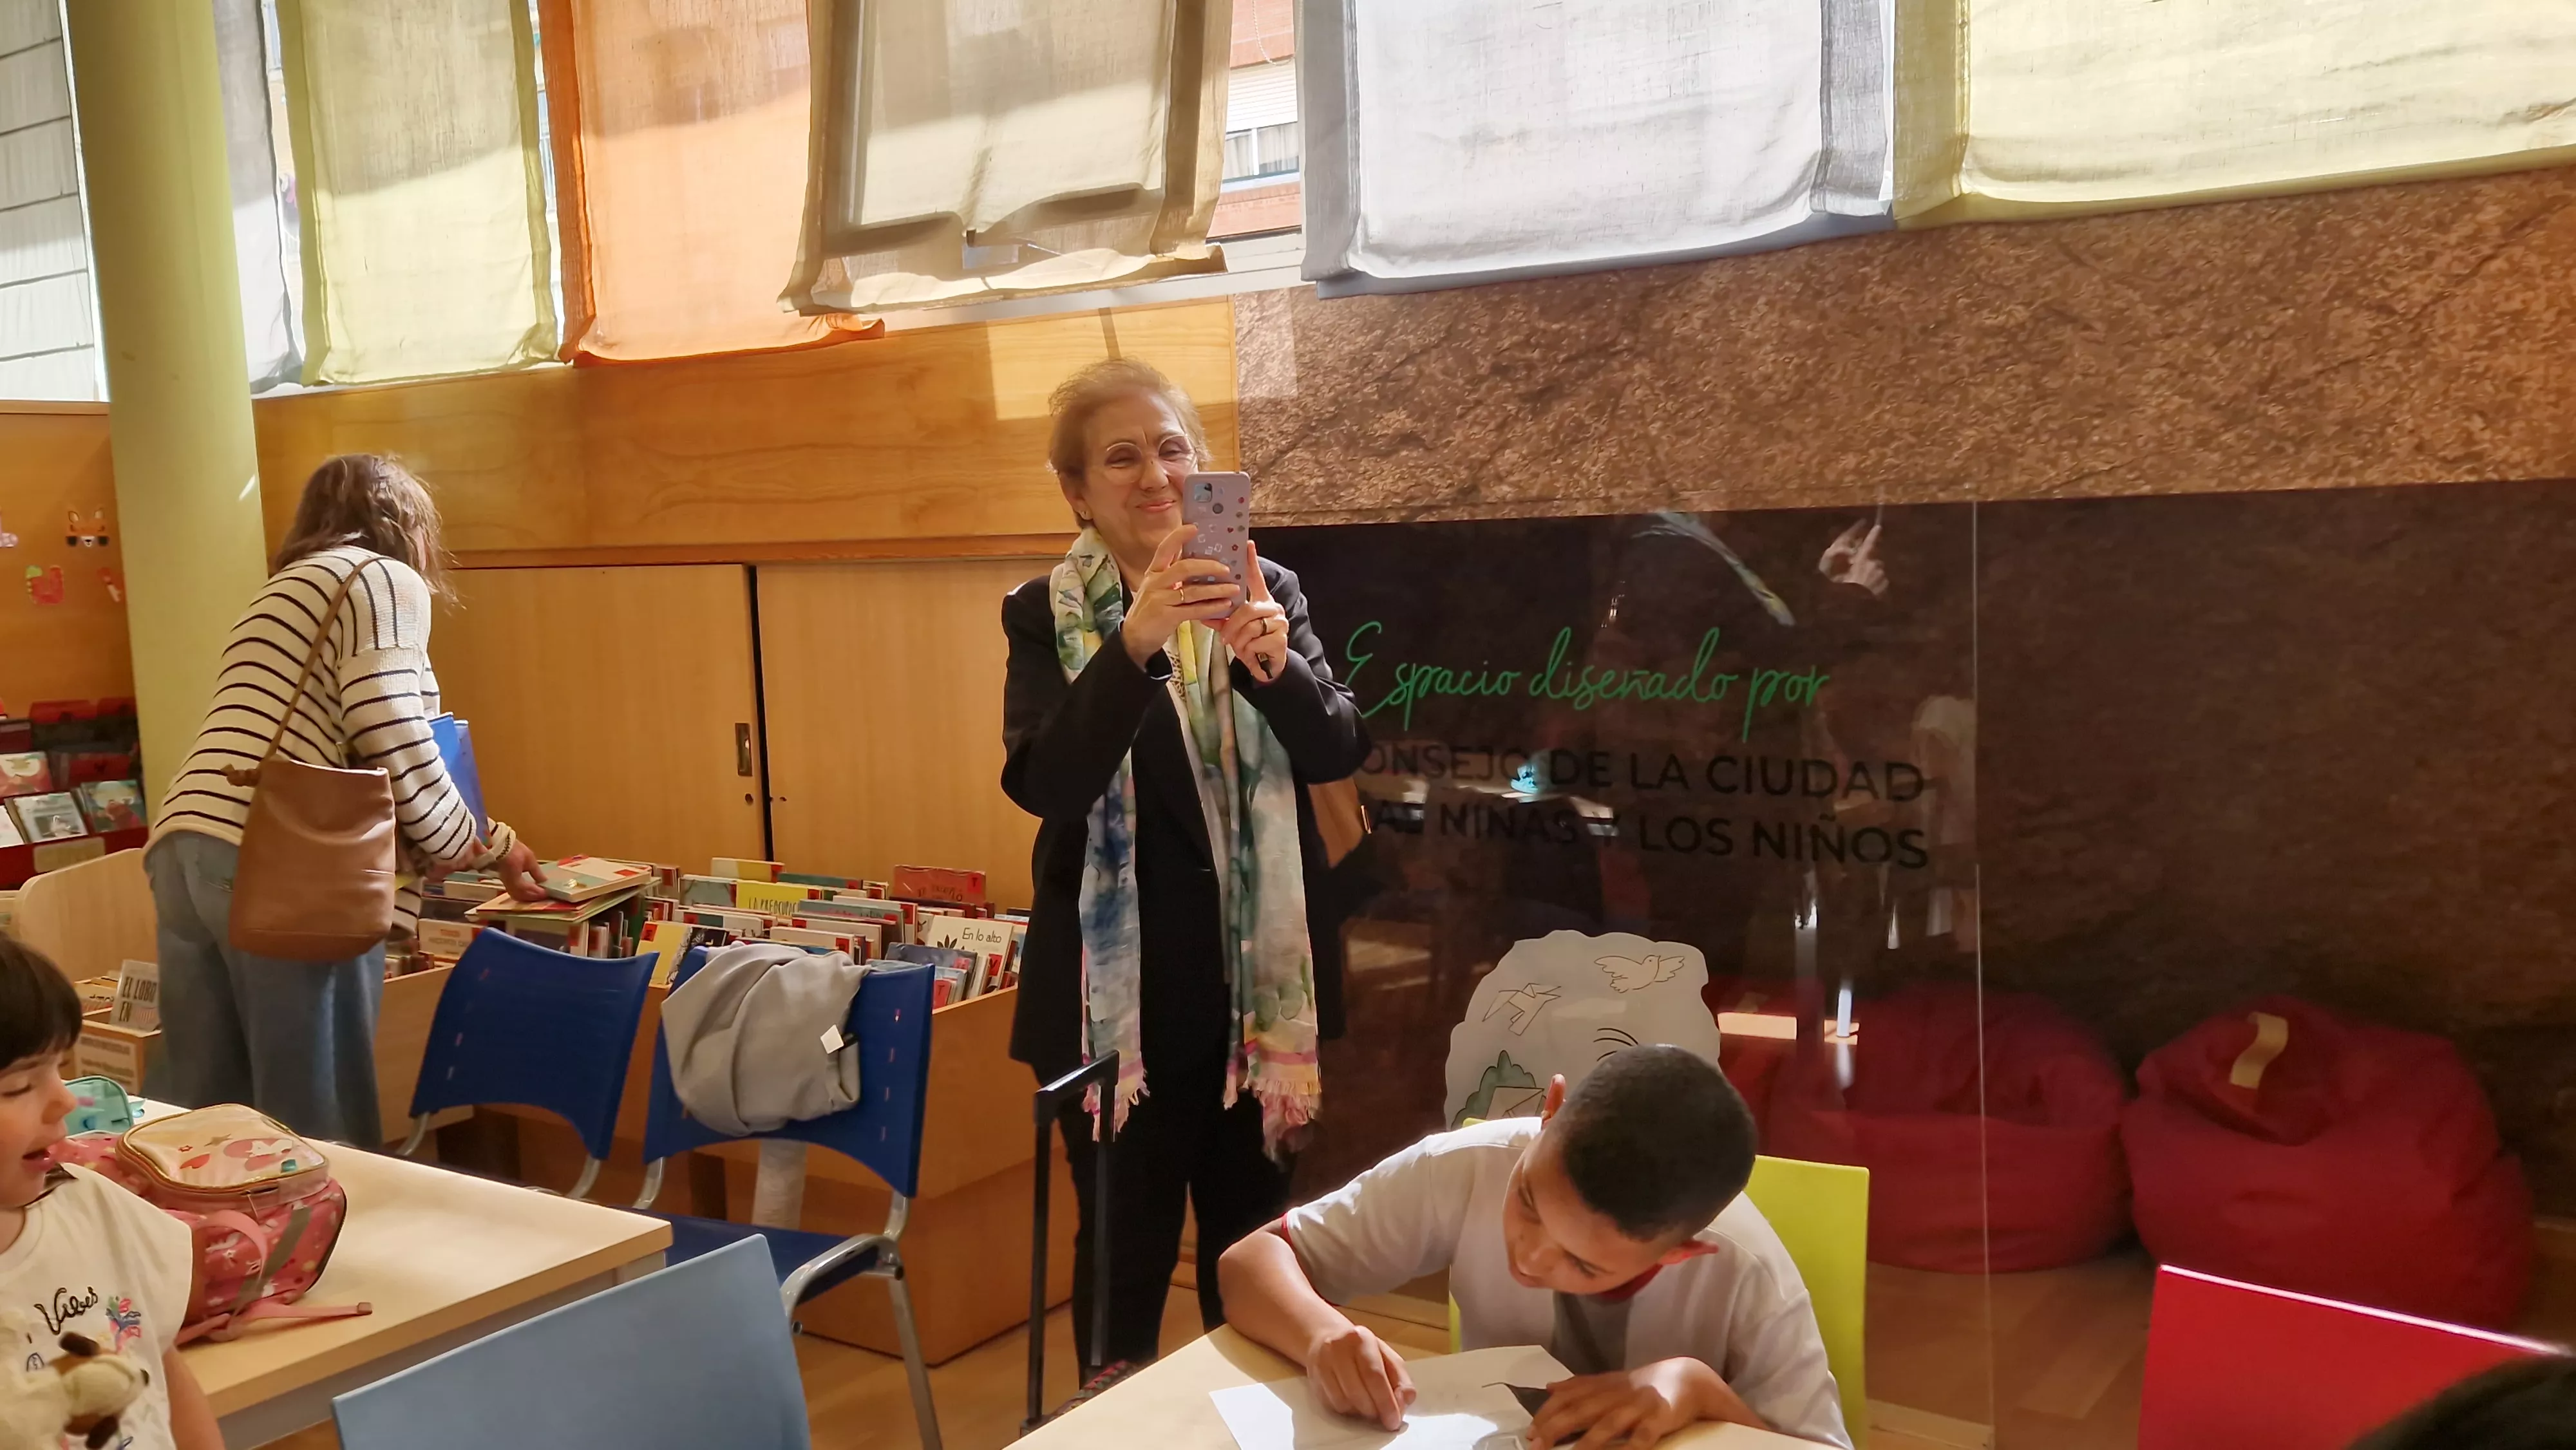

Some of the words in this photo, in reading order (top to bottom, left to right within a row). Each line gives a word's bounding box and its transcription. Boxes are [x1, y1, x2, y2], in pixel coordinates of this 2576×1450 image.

[1345, 621, 1522, 731] Espacio
[1743, 664, 1830, 744] por
[1360, 743, 1535, 782] ONSEJO
[1549, 748, 1613, 787] DE
[1630, 752, 1689, 790] LA
[1705, 754, 1924, 802] CIUDAD
[1638, 814, 1734, 856] LOS
[1752, 813, 1929, 870] NIÑOS
[961, 927, 974, 940] En
[975, 928, 984, 941] lo
[986, 930, 1002, 943] alto
[122, 976, 133, 998] EL
[133, 979, 158, 1003] LOBO
[119, 1001, 132, 1022] EN
